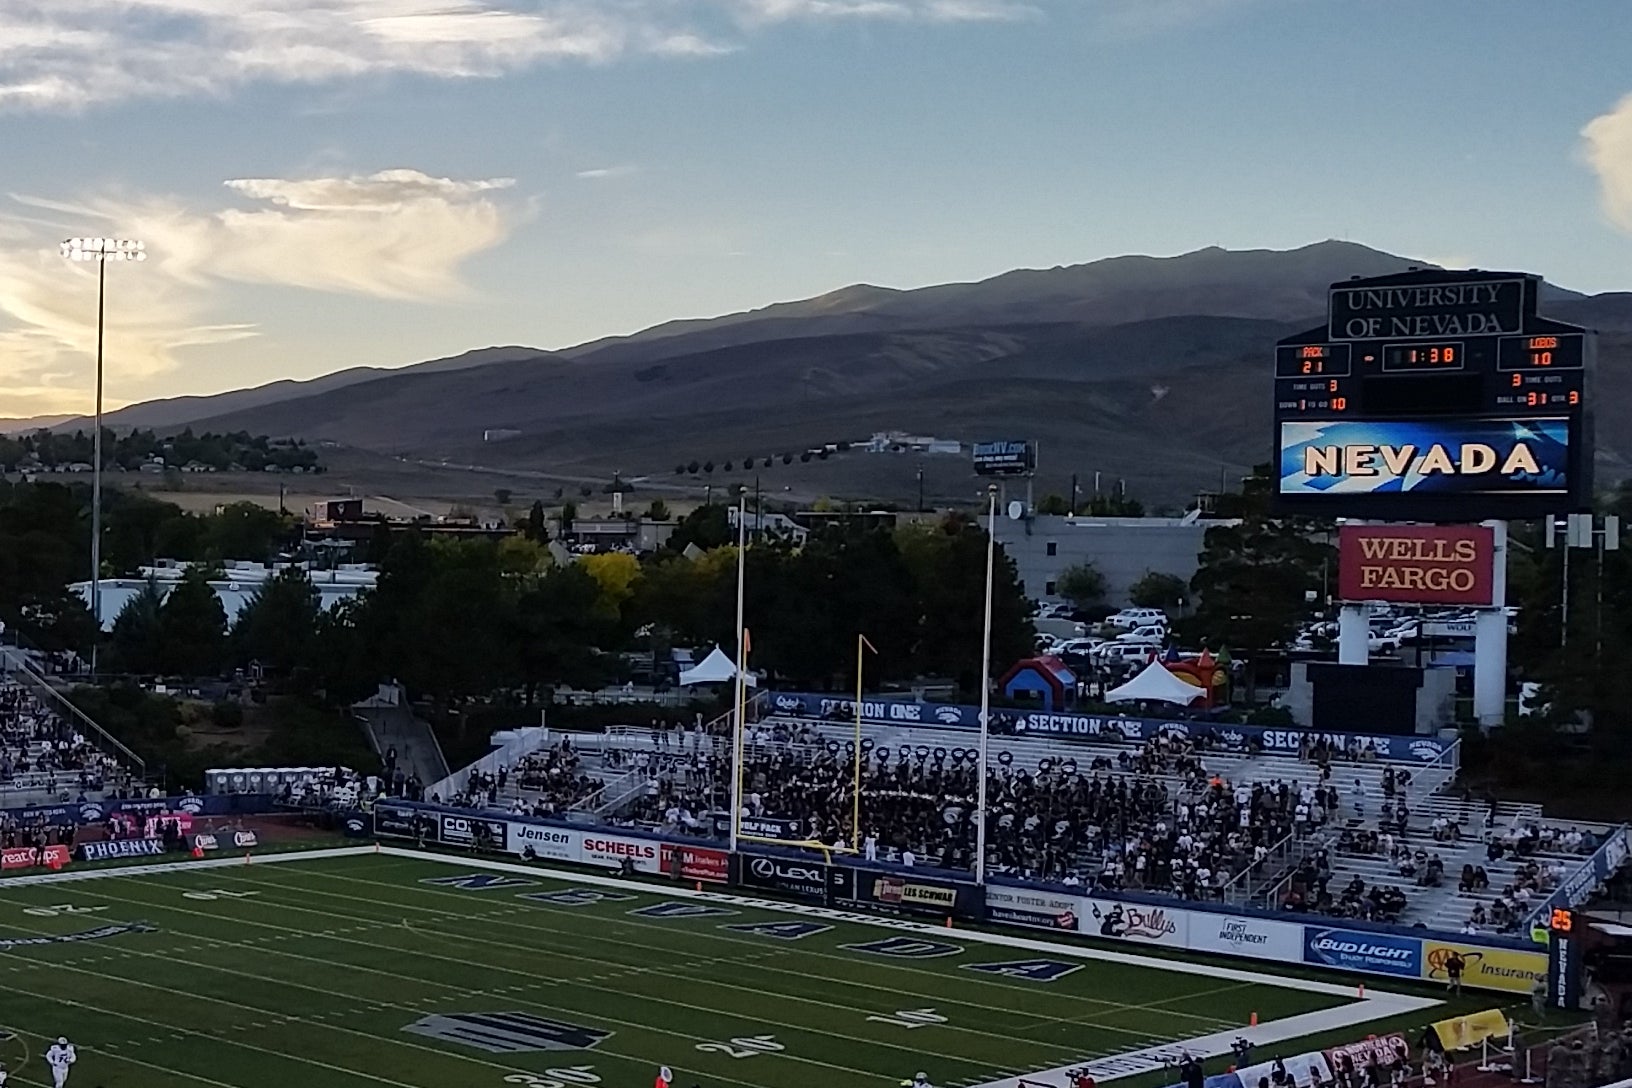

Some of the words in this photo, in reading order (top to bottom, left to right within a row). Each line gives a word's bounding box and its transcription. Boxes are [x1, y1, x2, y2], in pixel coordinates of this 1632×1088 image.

[1347, 284, 1503, 311] UNIVERSITY
[1345, 317, 1381, 338] OF
[1389, 313, 1503, 338] NEVADA
[1528, 337, 1557, 349] LOBOS
[1409, 347, 1455, 363] 1:38
[1532, 352, 1552, 366] 10
[1302, 361, 1324, 374] 21
[1330, 379, 1338, 392] 3
[1512, 373, 1522, 387] 3
[1331, 397, 1347, 411] 10
[1528, 391, 1548, 406] 31
[1569, 391, 1580, 405] 3
[1304, 443, 1542, 477] NEVADA
[1359, 538, 1477, 563] WELLS
[1360, 566, 1476, 592] FARGO
[1029, 714, 1101, 734] SECTION
[518, 827, 569, 844] Jensen
[85, 839, 165, 861] PHOENIX
[584, 839, 655, 859] SCHEELS
[1, 851, 29, 866] reat
[904, 888, 916, 897] LES
[418, 873, 1087, 982] NEVADA
[1552, 908, 1572, 930] 25
[1219, 932, 1268, 946] INDEPENDENT
[1557, 939, 1567, 1008] NEVADA
[696, 1036, 785, 1059] 20
